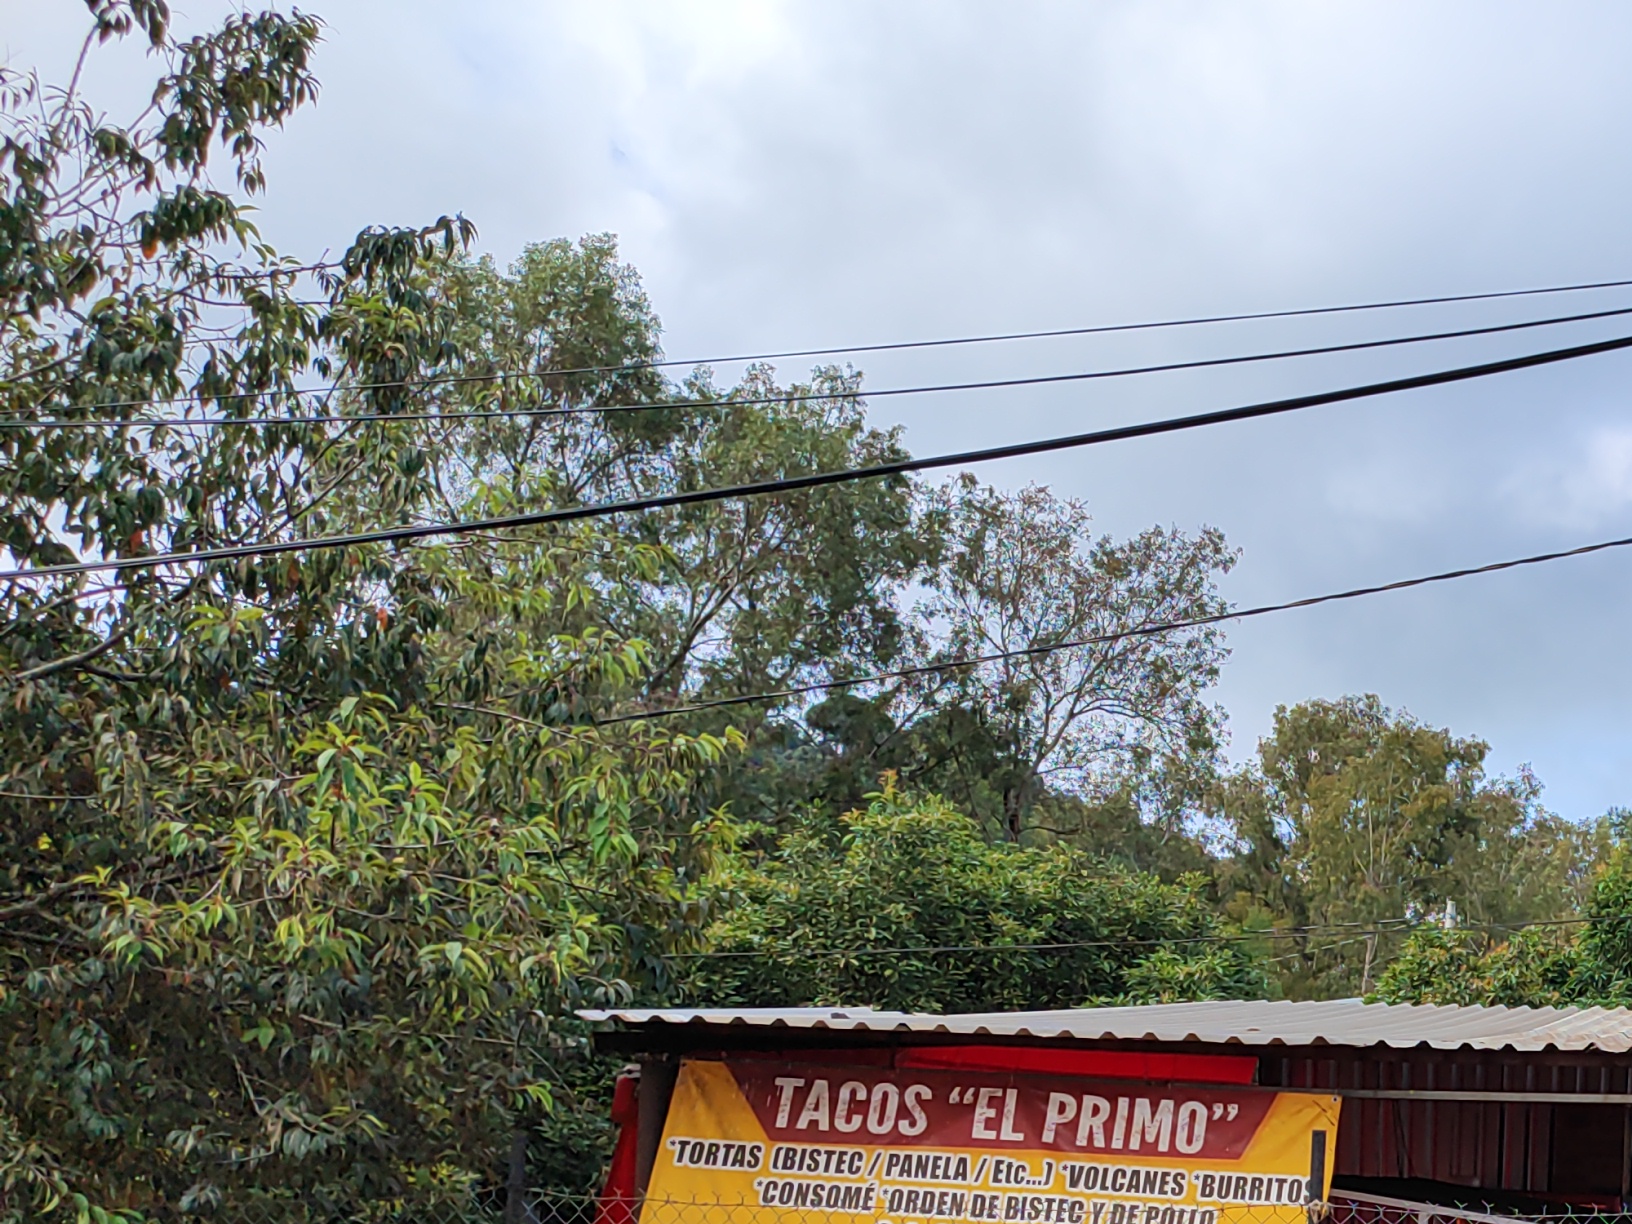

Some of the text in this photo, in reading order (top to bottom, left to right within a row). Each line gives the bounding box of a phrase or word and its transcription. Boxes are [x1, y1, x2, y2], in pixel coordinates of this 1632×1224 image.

[774, 1077, 932, 1136] TACOS
[885, 1152, 968, 1182] PANELA
[970, 1193, 999, 1220] DE
[1004, 1195, 1083, 1224] BISTEC
